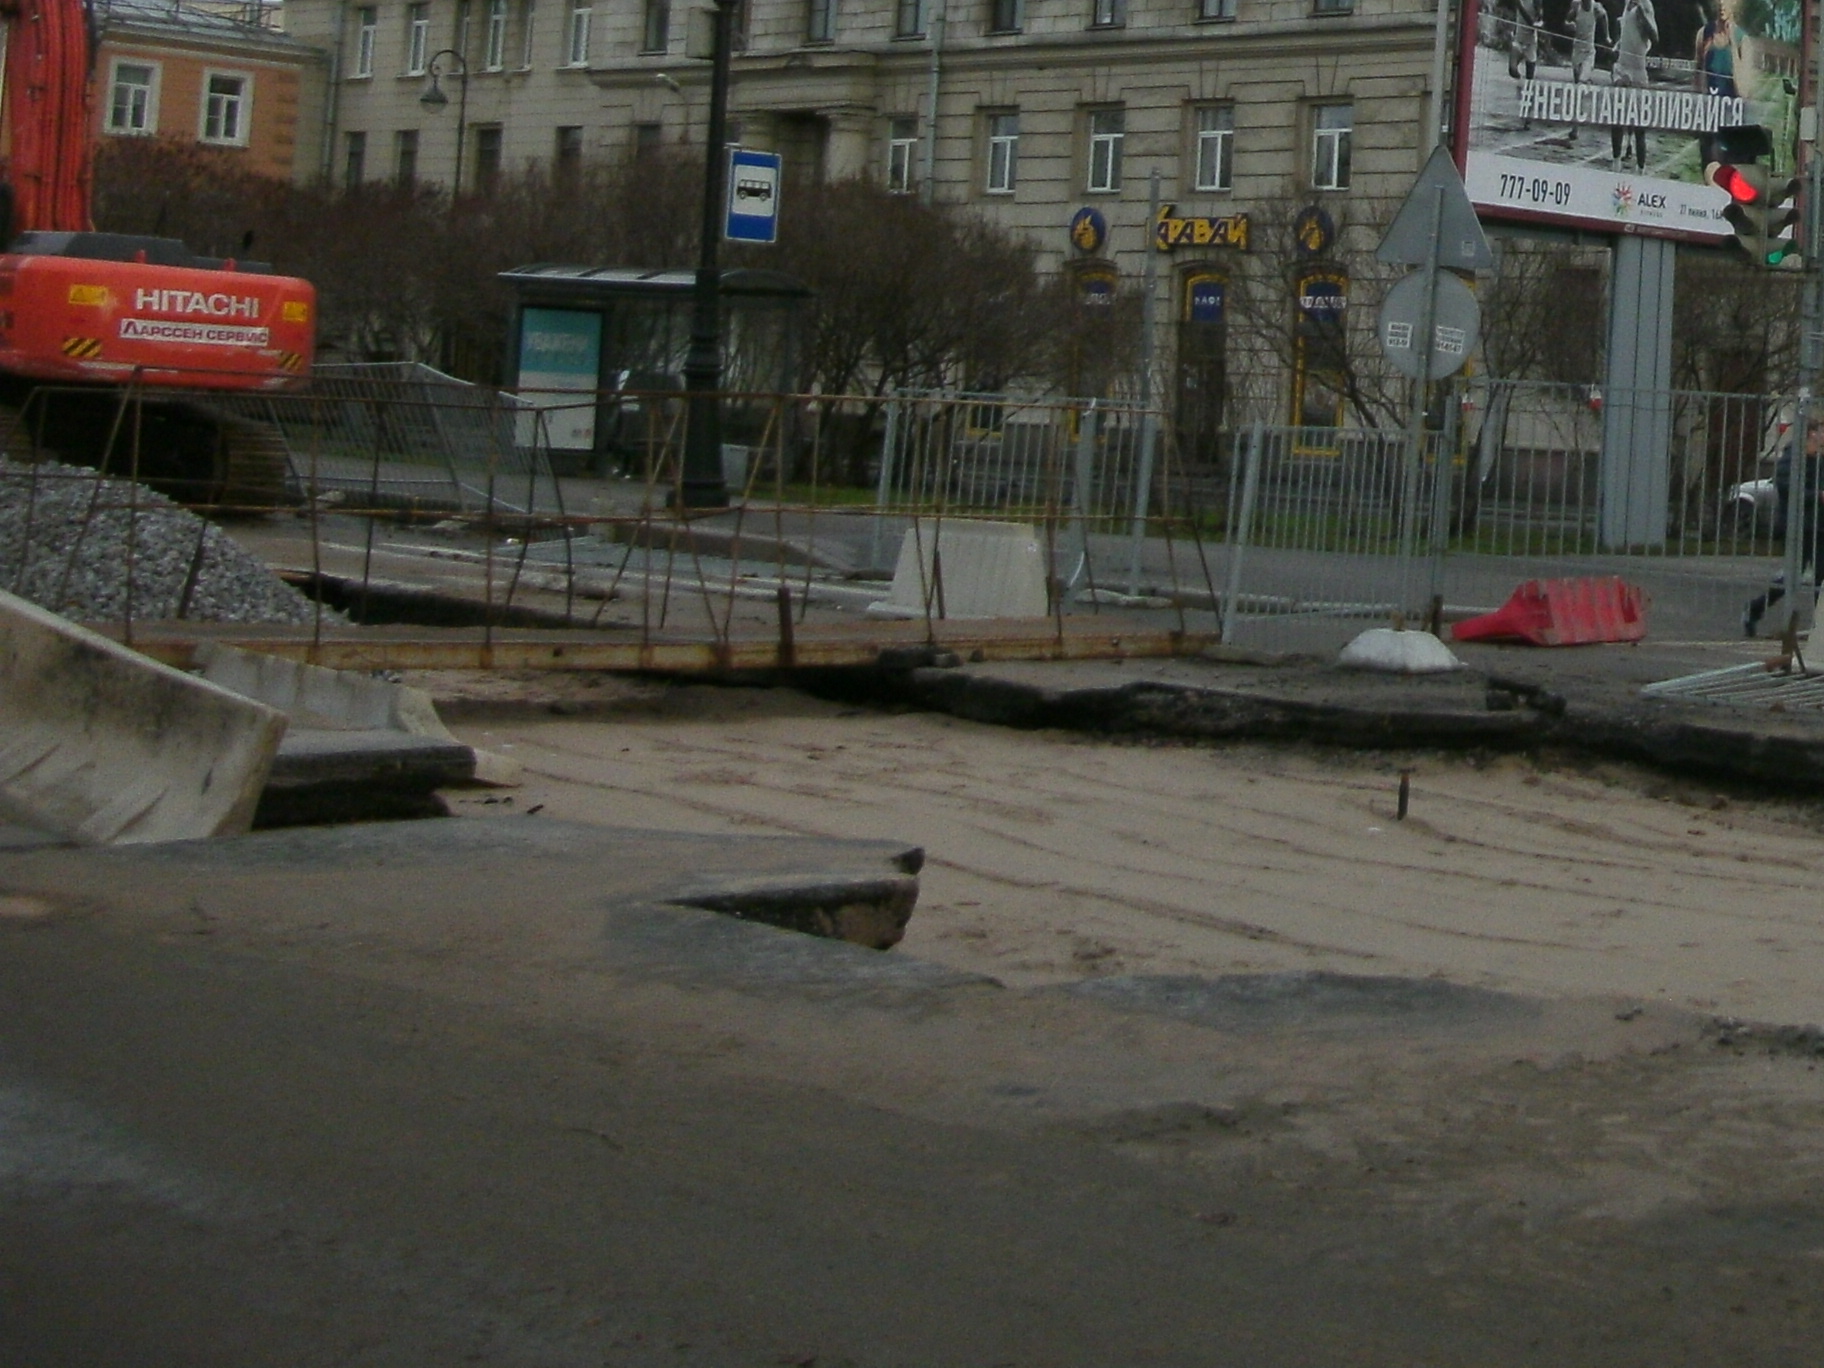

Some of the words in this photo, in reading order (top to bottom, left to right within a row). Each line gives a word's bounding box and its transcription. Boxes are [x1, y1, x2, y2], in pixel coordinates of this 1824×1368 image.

[1519, 79, 1744, 132] #НЕОСТАНАВЛИВАЙСЯ
[1500, 174, 1571, 206] 777-09-09
[1637, 192, 1666, 209] ALEX
[136, 288, 259, 318] HITACHI
[123, 320, 202, 340] ЛАРССЕН
[206, 328, 268, 343] СЕРВИС
